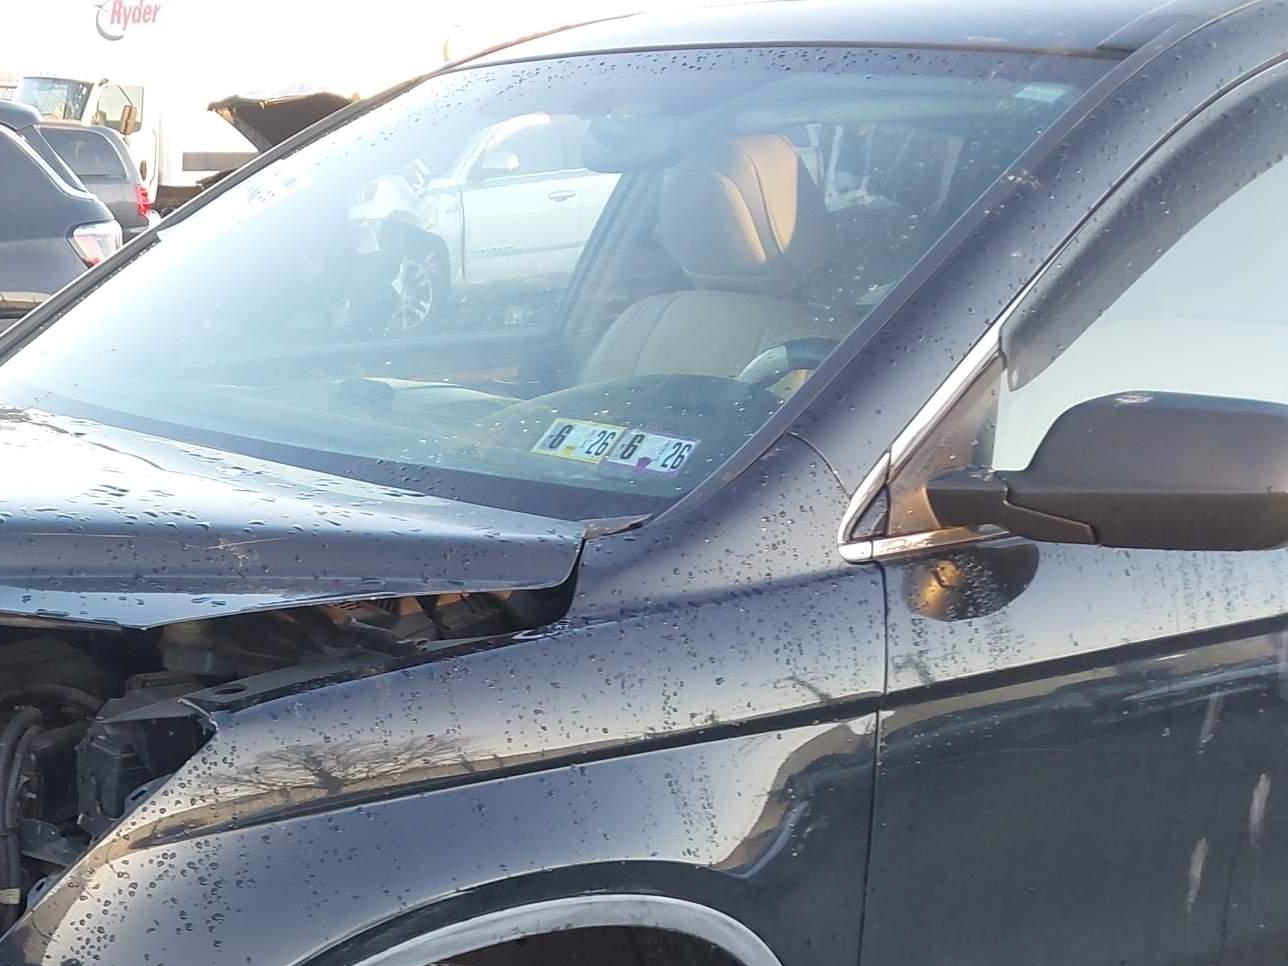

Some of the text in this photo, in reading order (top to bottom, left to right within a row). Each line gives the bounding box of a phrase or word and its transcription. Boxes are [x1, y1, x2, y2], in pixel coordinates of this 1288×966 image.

[110, 0, 161, 31] Ryder
[585, 430, 617, 456] 26
[660, 441, 692, 470] 26
